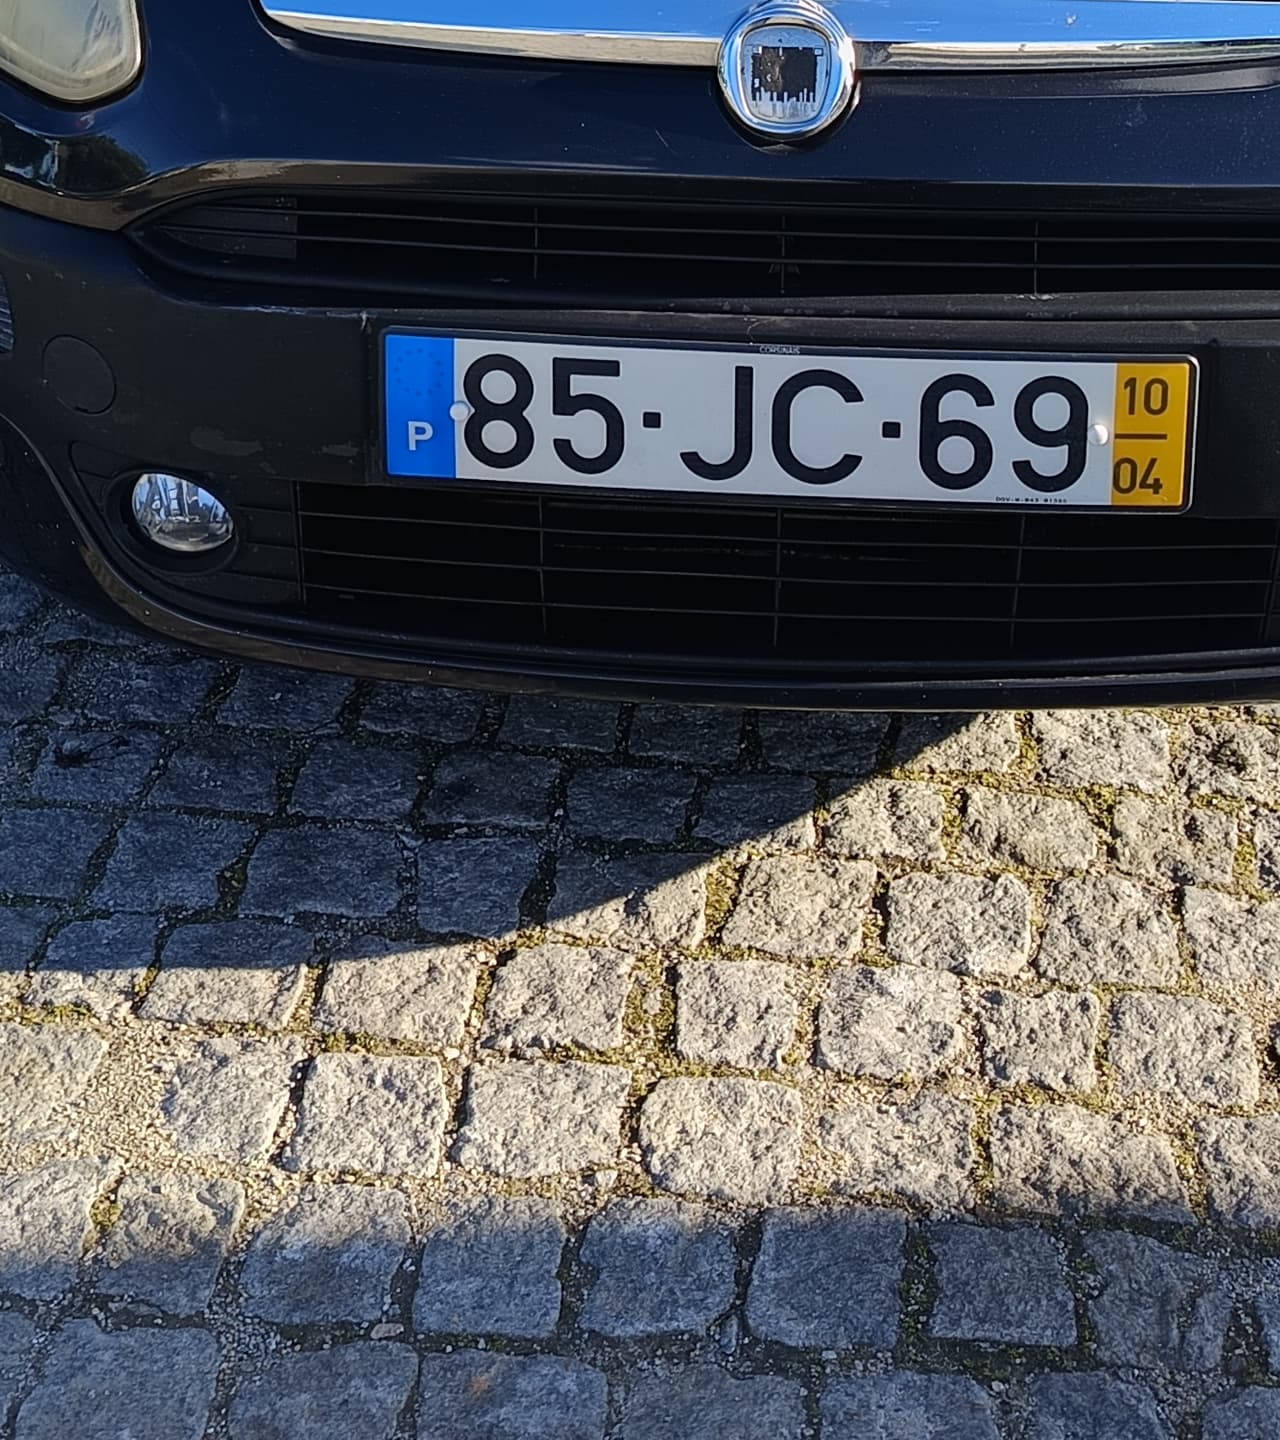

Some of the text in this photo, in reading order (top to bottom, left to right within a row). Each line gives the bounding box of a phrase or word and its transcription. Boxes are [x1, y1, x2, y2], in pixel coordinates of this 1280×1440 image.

[1123, 376, 1169, 416] 10
[407, 420, 434, 451] P
[1112, 457, 1164, 495] 04
